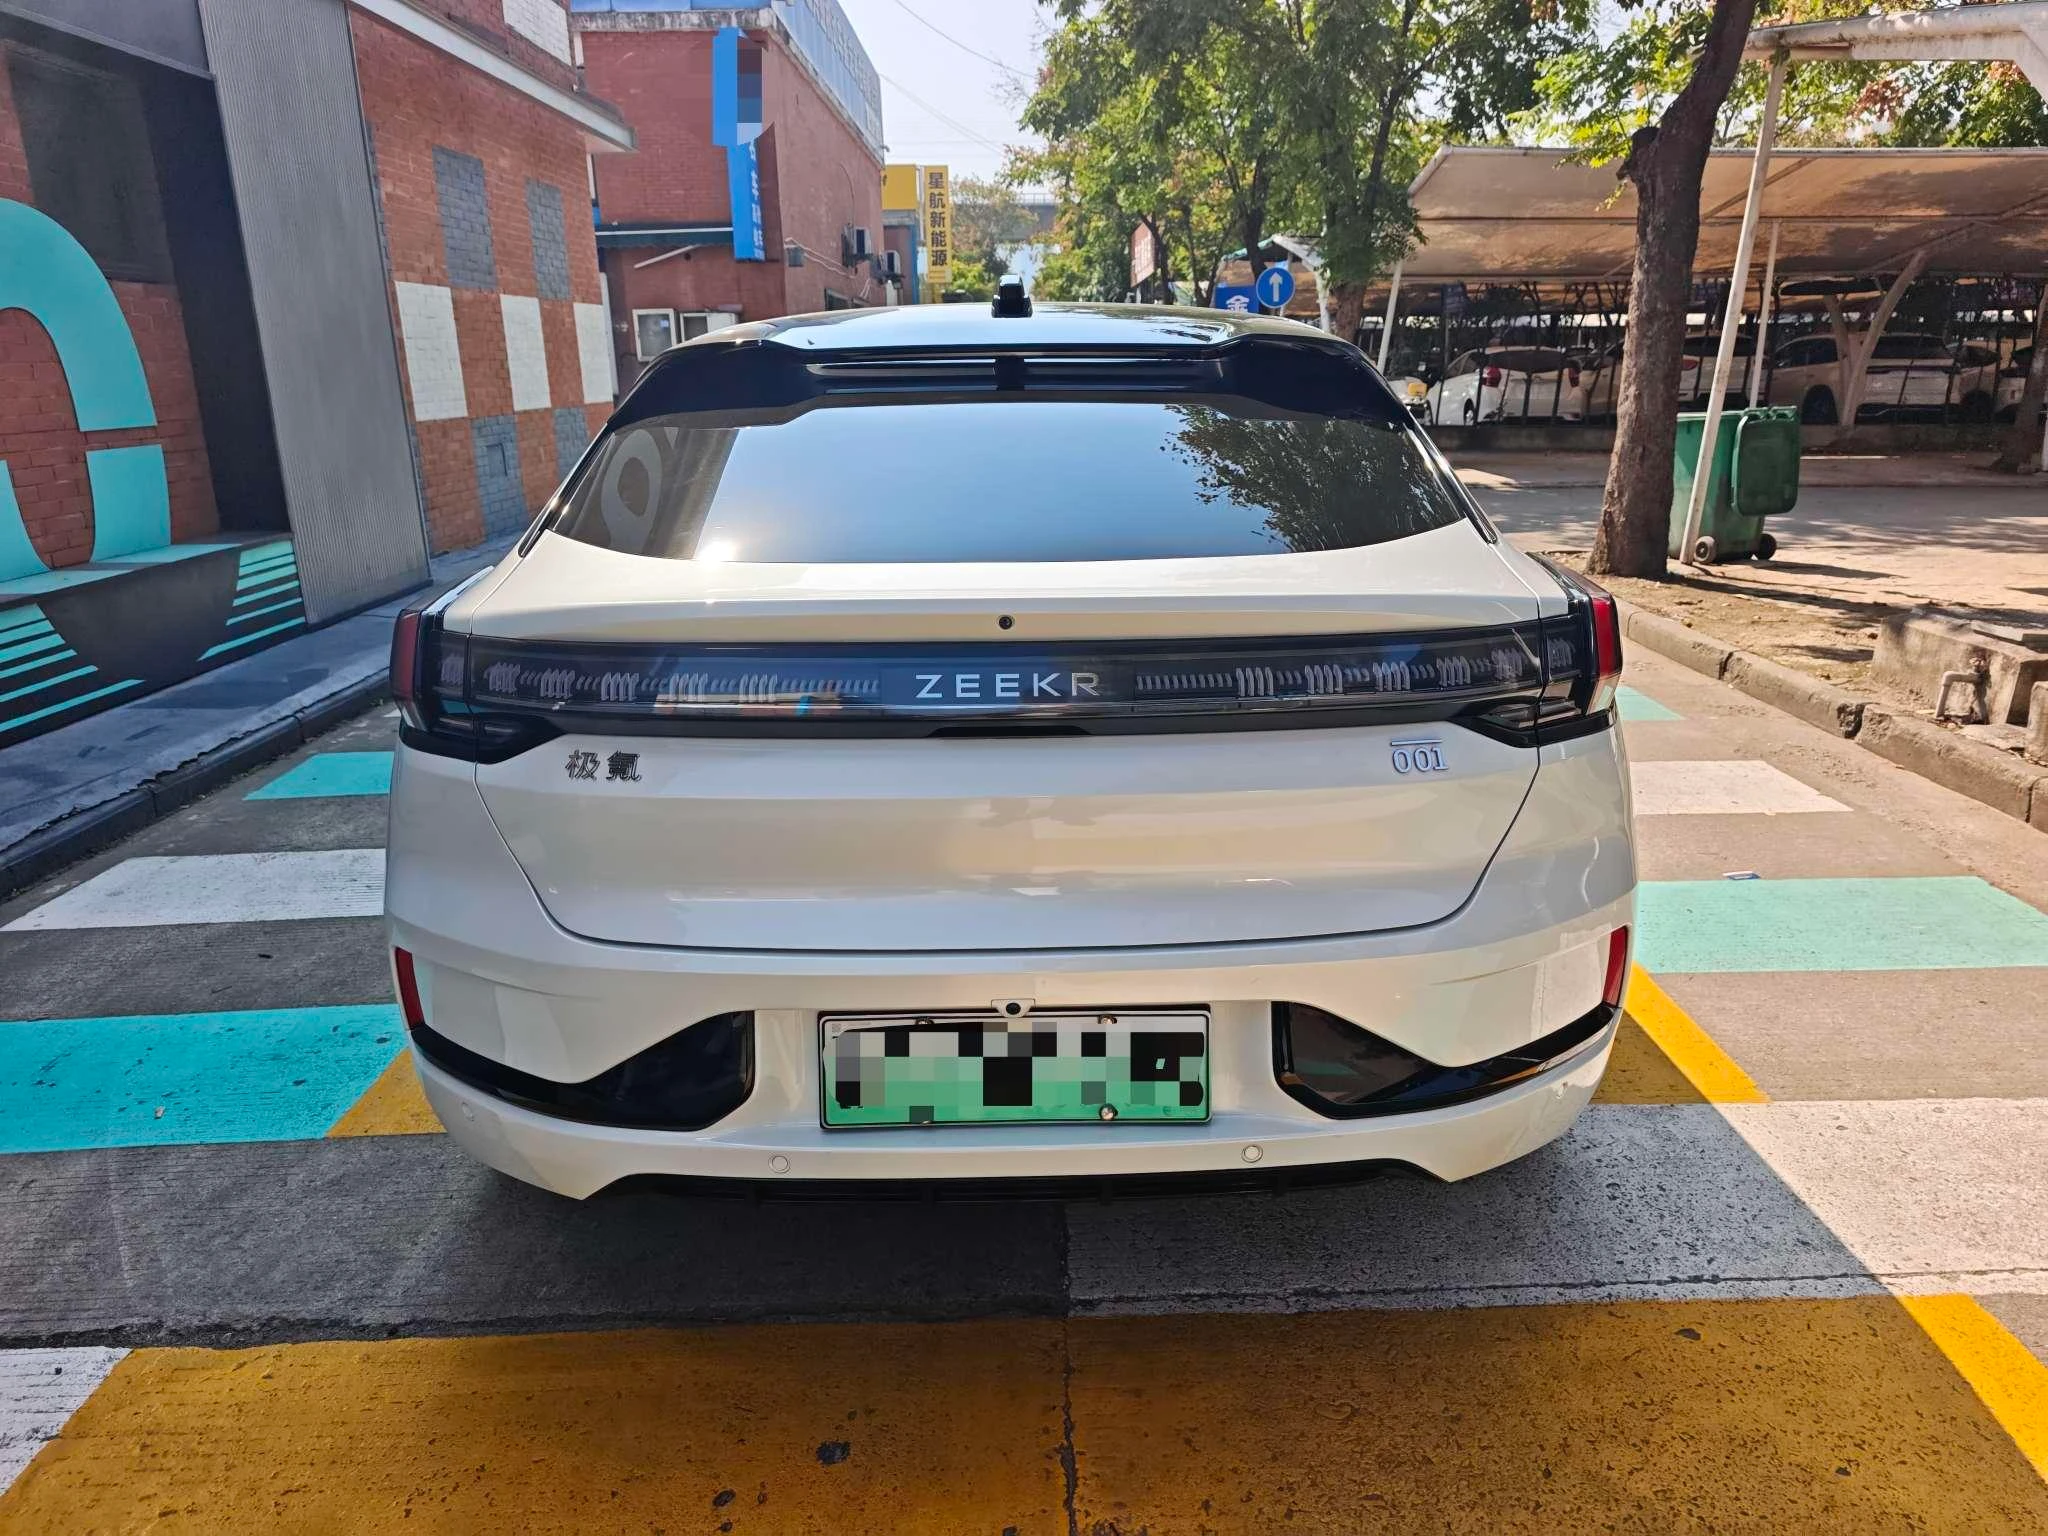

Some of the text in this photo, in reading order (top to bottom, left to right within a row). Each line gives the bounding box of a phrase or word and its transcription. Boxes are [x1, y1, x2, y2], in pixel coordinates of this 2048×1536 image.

[928, 171, 948, 267] 星航新能源
[915, 672, 1100, 698] ZEEKR
[1391, 746, 1449, 774] 001
